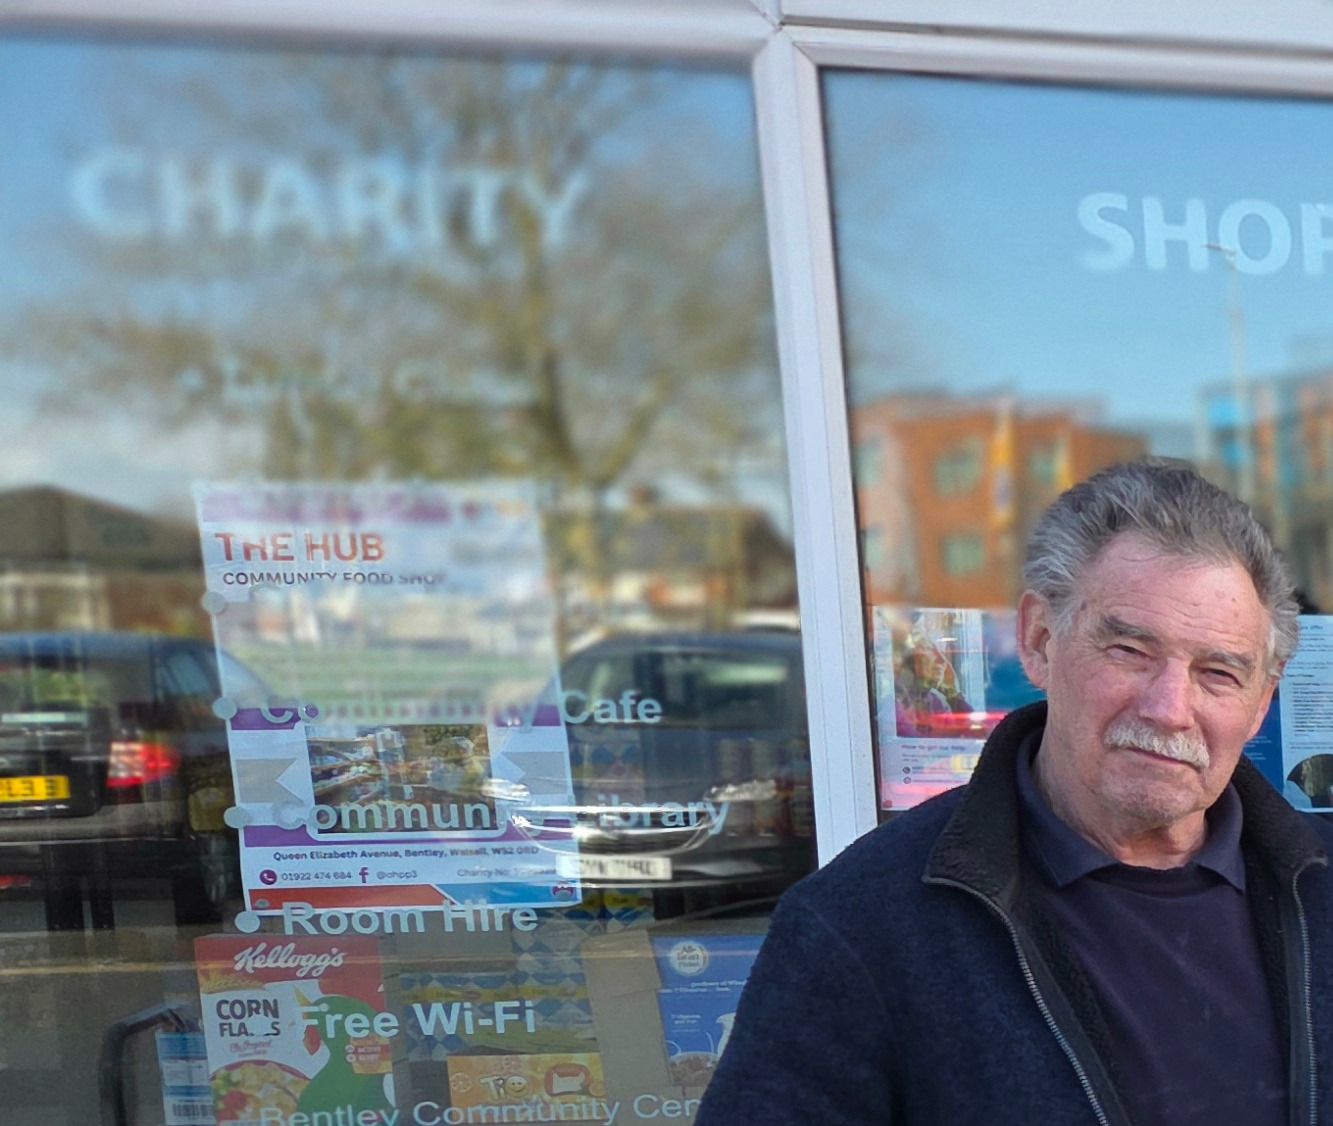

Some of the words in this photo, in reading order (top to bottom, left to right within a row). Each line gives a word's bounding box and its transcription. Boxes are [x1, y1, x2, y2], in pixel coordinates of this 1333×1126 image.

[70, 147, 591, 246] CHARITY
[214, 532, 295, 562] THE
[305, 532, 387, 562] HUB
[222, 571, 338, 586] COMMUNITY
[343, 572, 394, 586] FOOD
[560, 689, 664, 724] Cafe
[273, 852, 307, 861] Queen
[310, 851, 358, 860] Elizabeth
[360, 850, 402, 860] Avenue,
[405, 849, 447, 858] Bentley,
[281, 901, 426, 935] Room
[443, 899, 539, 932] Hire
[234, 942, 347, 977] Kellogg's
[215, 998, 280, 1020] CORN
[298, 1003, 400, 1039] Free
[411, 1001, 536, 1036] Wi-Fi
[219, 1020, 281, 1037] FLAS
[412, 1096, 620, 1126] Community
[633, 1094, 702, 1119] Cen
